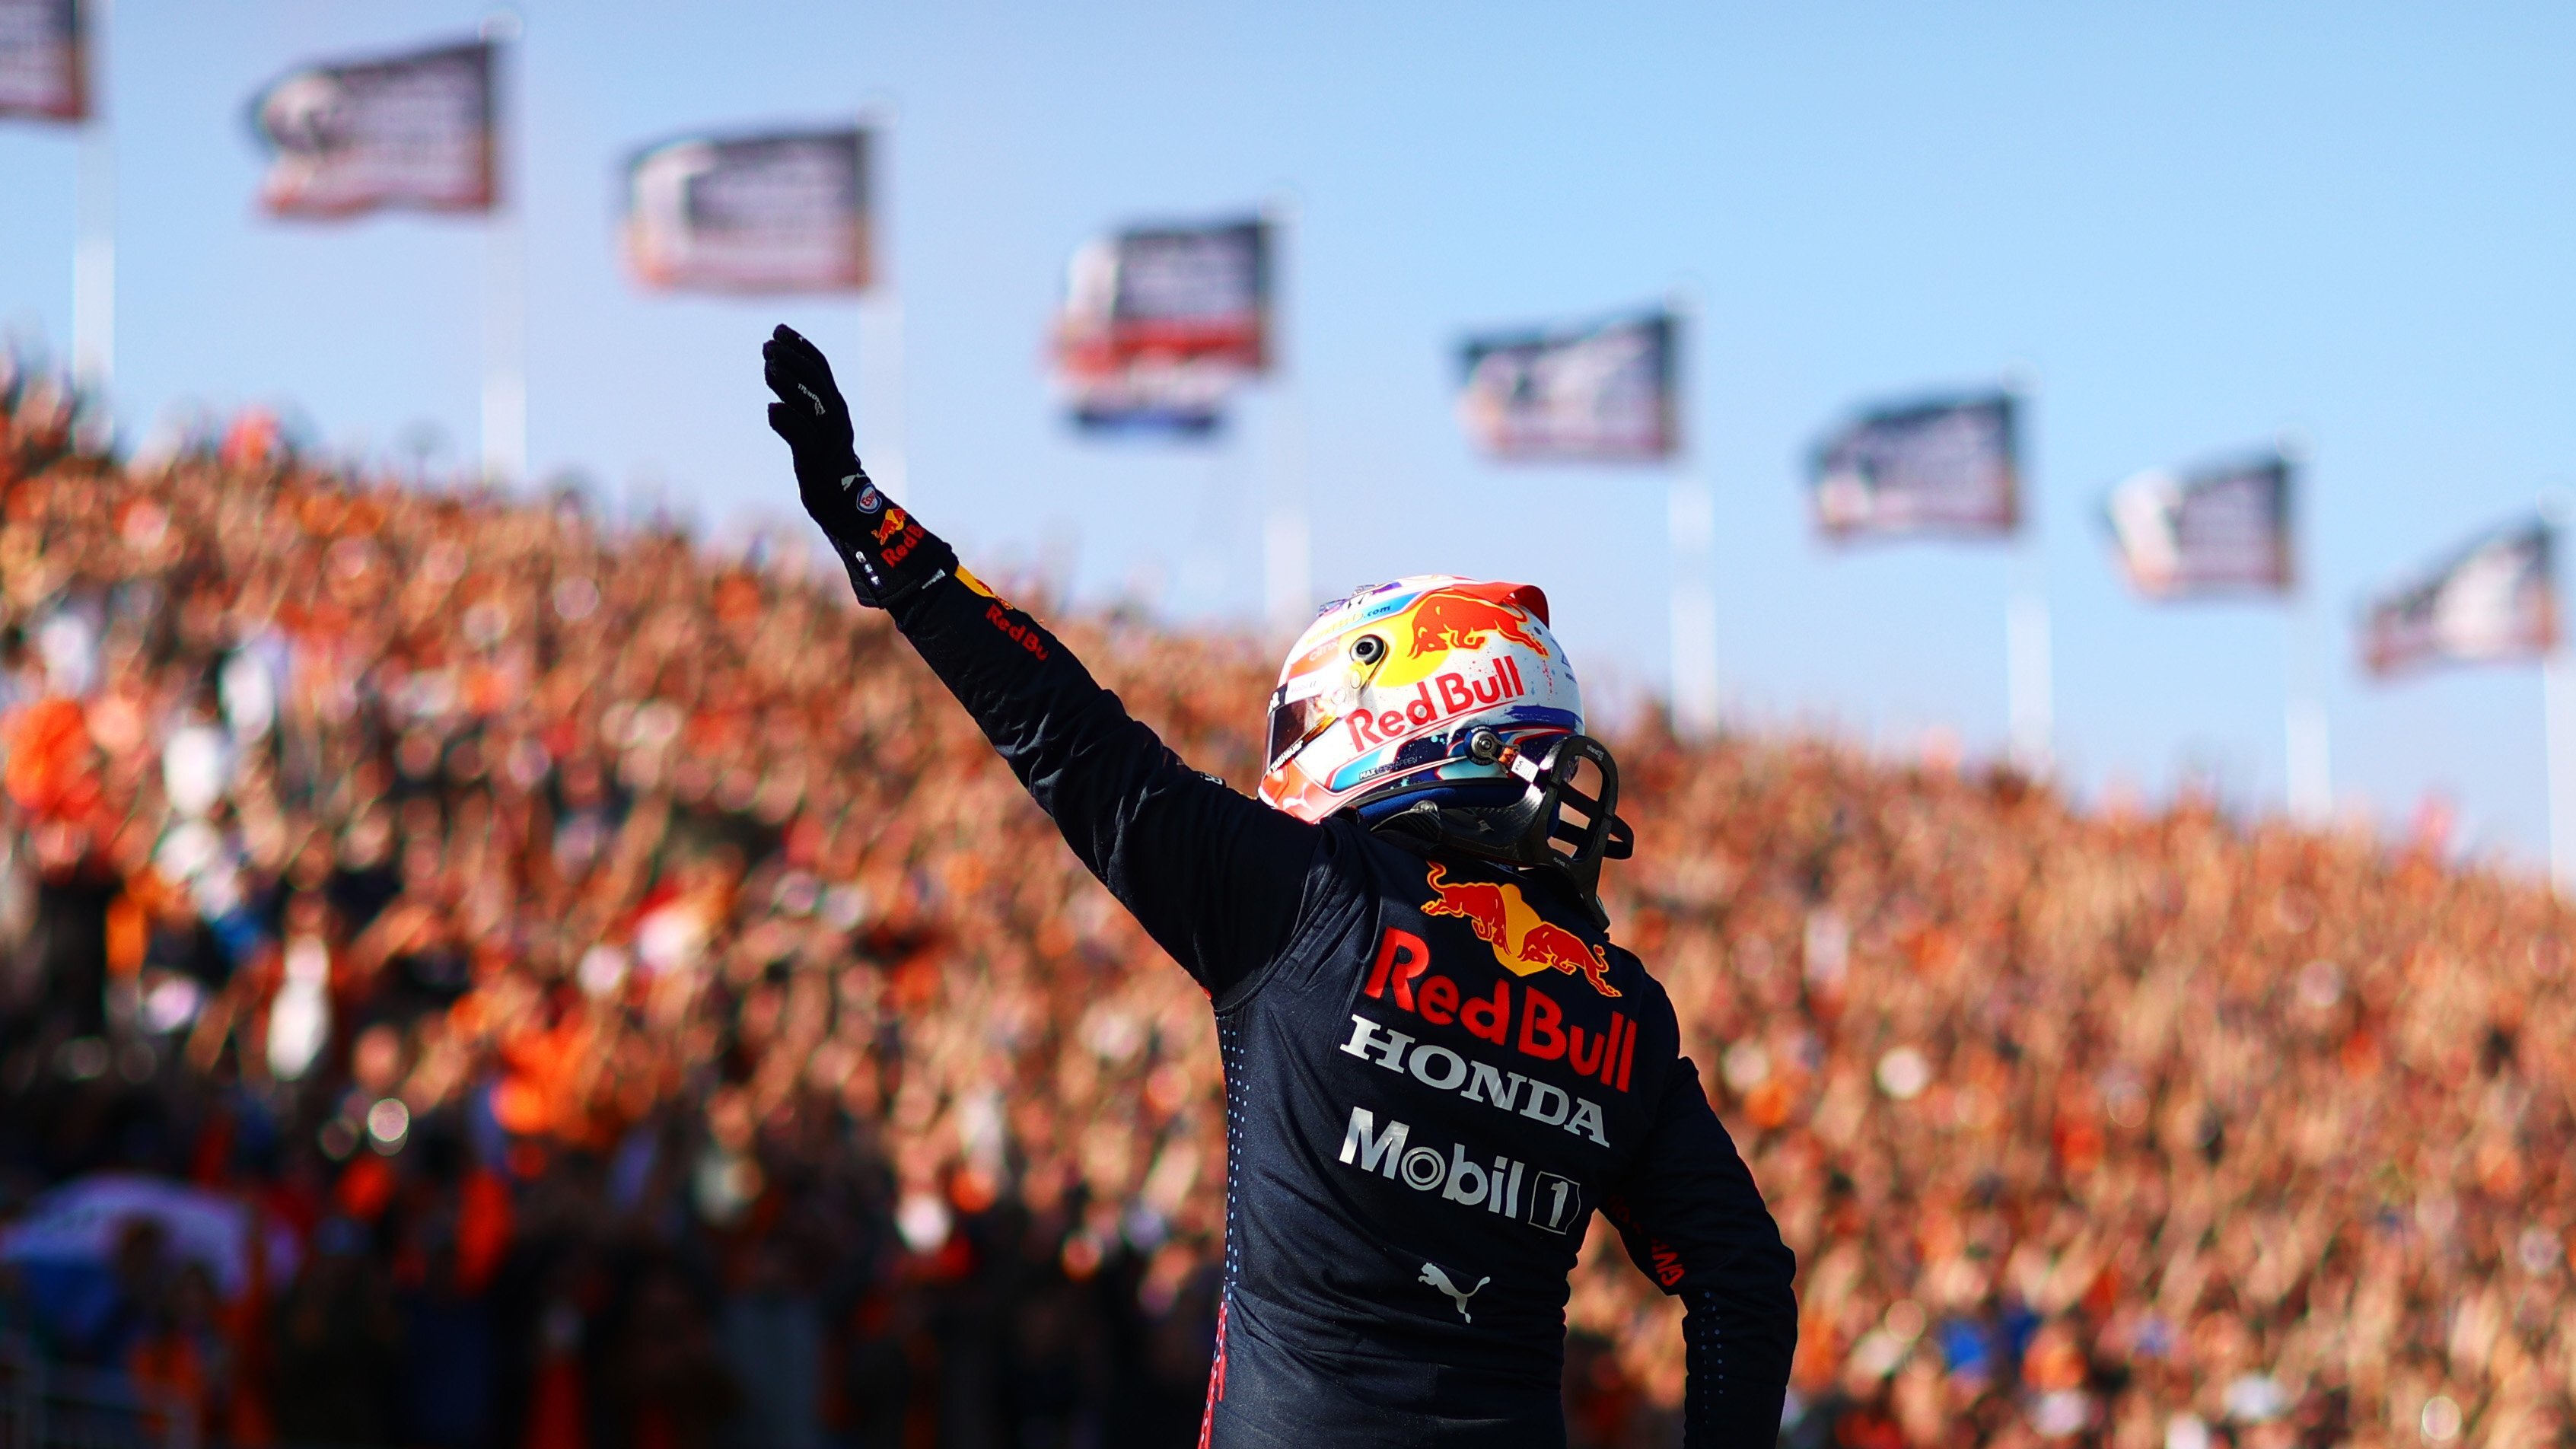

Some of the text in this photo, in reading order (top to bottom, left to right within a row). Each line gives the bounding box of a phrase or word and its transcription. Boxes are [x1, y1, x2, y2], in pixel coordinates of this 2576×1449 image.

[880, 528, 918, 568] Red
[986, 604, 1027, 642] Red
[1345, 696, 1437, 753] Red
[1435, 655, 1524, 715] Bull
[1364, 926, 1637, 1093] Red Bull
[1339, 1014, 1610, 1148] HONDA
[1339, 1107, 1525, 1219] Mobil
